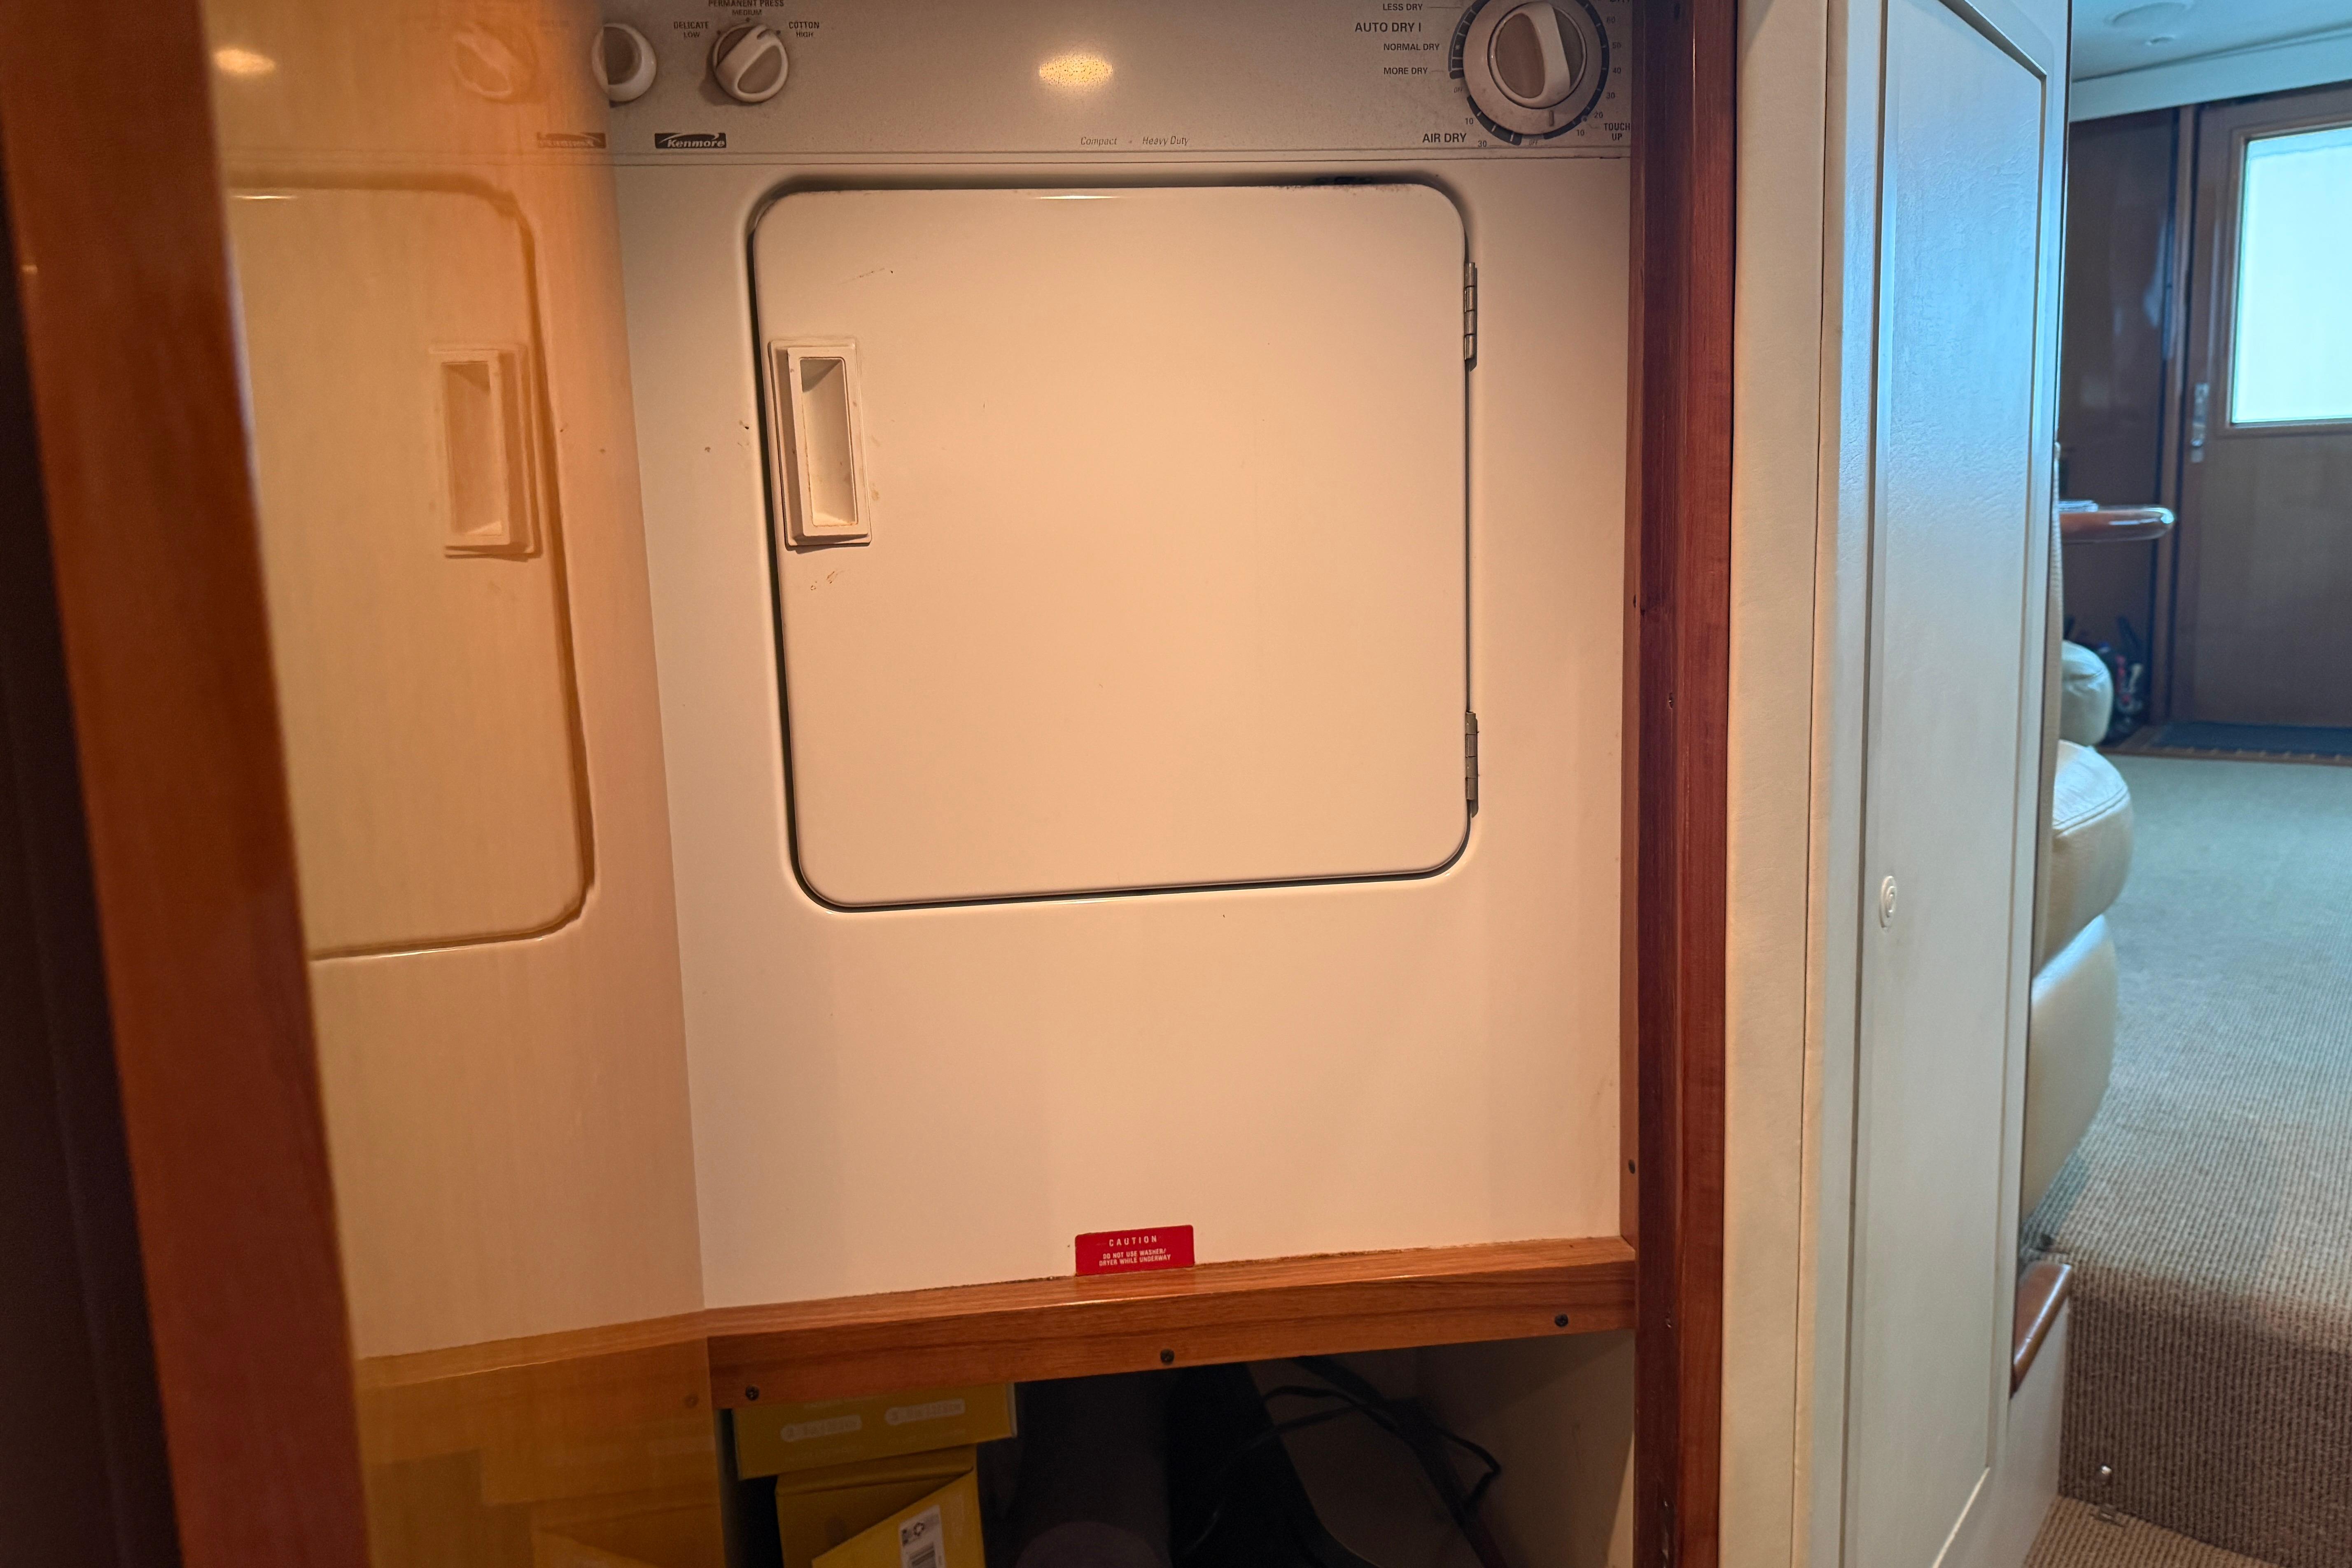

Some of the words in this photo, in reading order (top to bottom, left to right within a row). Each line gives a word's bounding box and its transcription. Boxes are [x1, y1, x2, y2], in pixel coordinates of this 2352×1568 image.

[1355, 22, 1388, 32] AUTO
[1392, 22, 1414, 32] DRY
[1604, 123, 1631, 131] TOUCH
[1080, 136, 1117, 147] Compact
[1143, 136, 1168, 146] Heavy
[1170, 136, 1190, 146] Duty
[1422, 133, 1441, 143] AIR
[1444, 133, 1467, 142] DRY
[1612, 133, 1623, 141] UP
[667, 139, 726, 148] Kenmore
[1109, 1235, 1158, 1246] CAUTION
[1139, 1248, 1166, 1256] WASHER/
[1139, 1254, 1171, 1263] UNDERWAY
